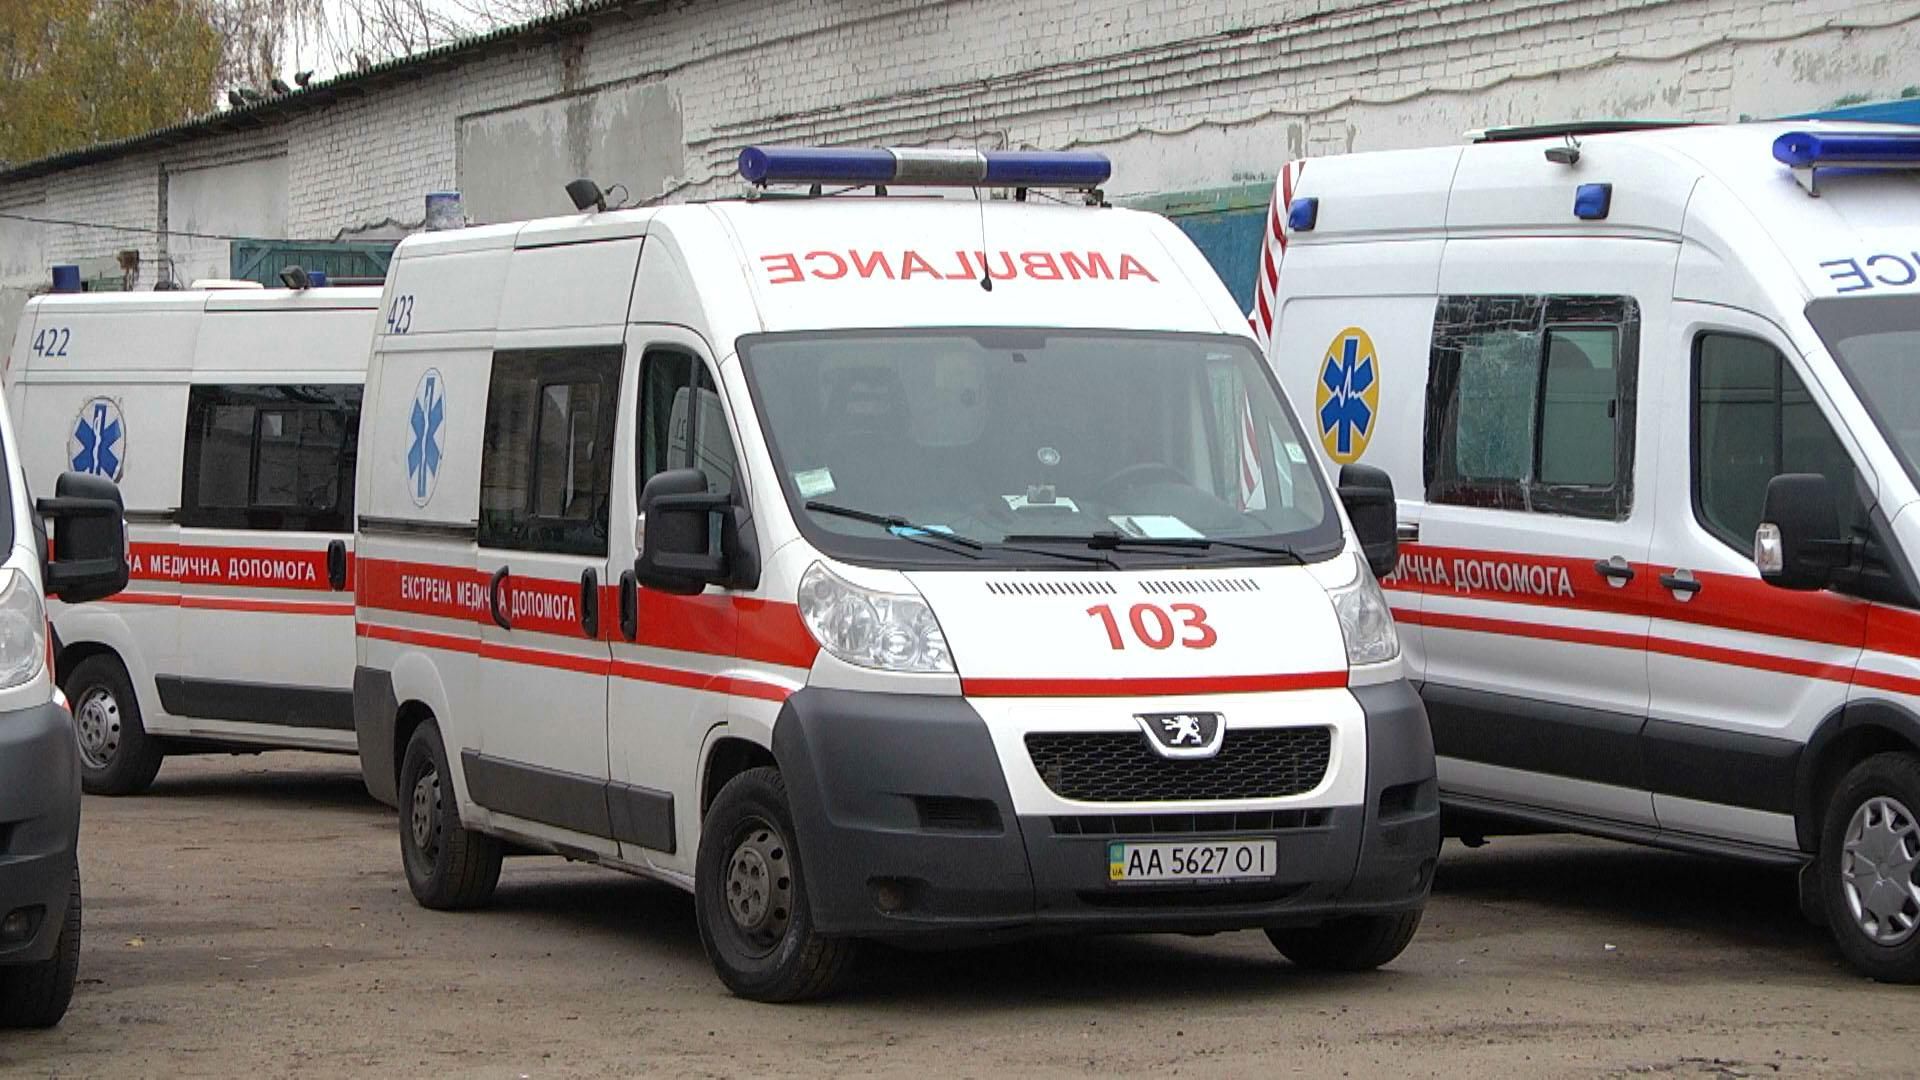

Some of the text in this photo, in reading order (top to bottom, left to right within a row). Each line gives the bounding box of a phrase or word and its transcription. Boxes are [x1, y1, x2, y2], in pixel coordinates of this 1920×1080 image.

[388, 294, 414, 335] 423
[33, 327, 70, 357] 422
[150, 555, 221, 577] МЕДИЧНА
[228, 557, 316, 581] ДОПОМОГА
[1453, 559, 1576, 598] ДОПОМОГА
[401, 575, 577, 622] ЕКСТРЕНА МЕДИЧА ДОПОМОГА
[1086, 603, 1218, 650] 103
[1112, 867, 1124, 876] UA
[1127, 849, 1164, 876] AA
[1171, 847, 1229, 875] 5627
